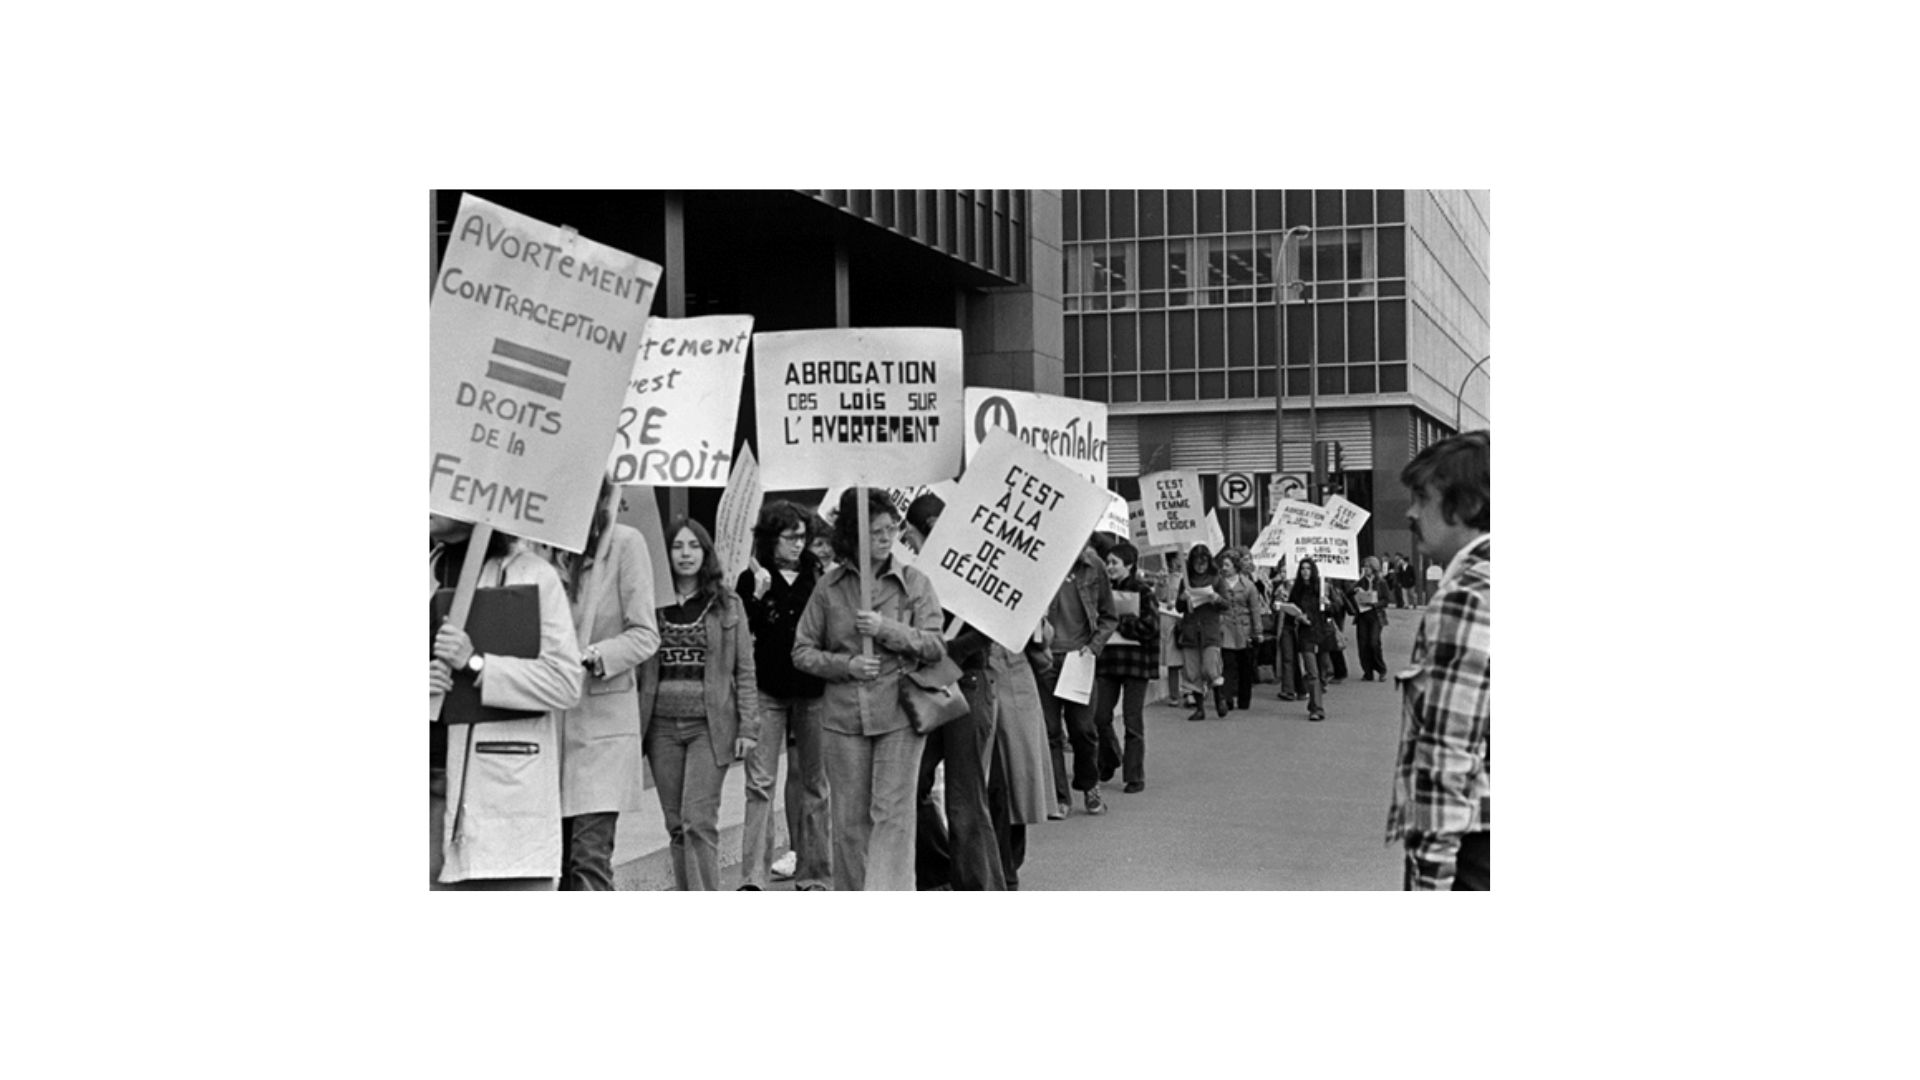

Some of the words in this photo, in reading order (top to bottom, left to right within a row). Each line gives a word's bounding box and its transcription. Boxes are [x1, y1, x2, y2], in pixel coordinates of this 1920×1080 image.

[639, 330, 748, 360] tement
[785, 361, 937, 385] ABROGATION
[456, 381, 562, 435] DROITS
[908, 392, 937, 411] SUR
[470, 423, 499, 449] DE
[812, 415, 939, 443] AVORTEMENT
[430, 452, 548, 524] FEMME
[1005, 465, 1064, 511] C'EST
[1014, 500, 1041, 531] LA
[970, 504, 1046, 562] FEMME
[975, 540, 1006, 570] DE
[940, 547, 1023, 611] DÉCIDER
